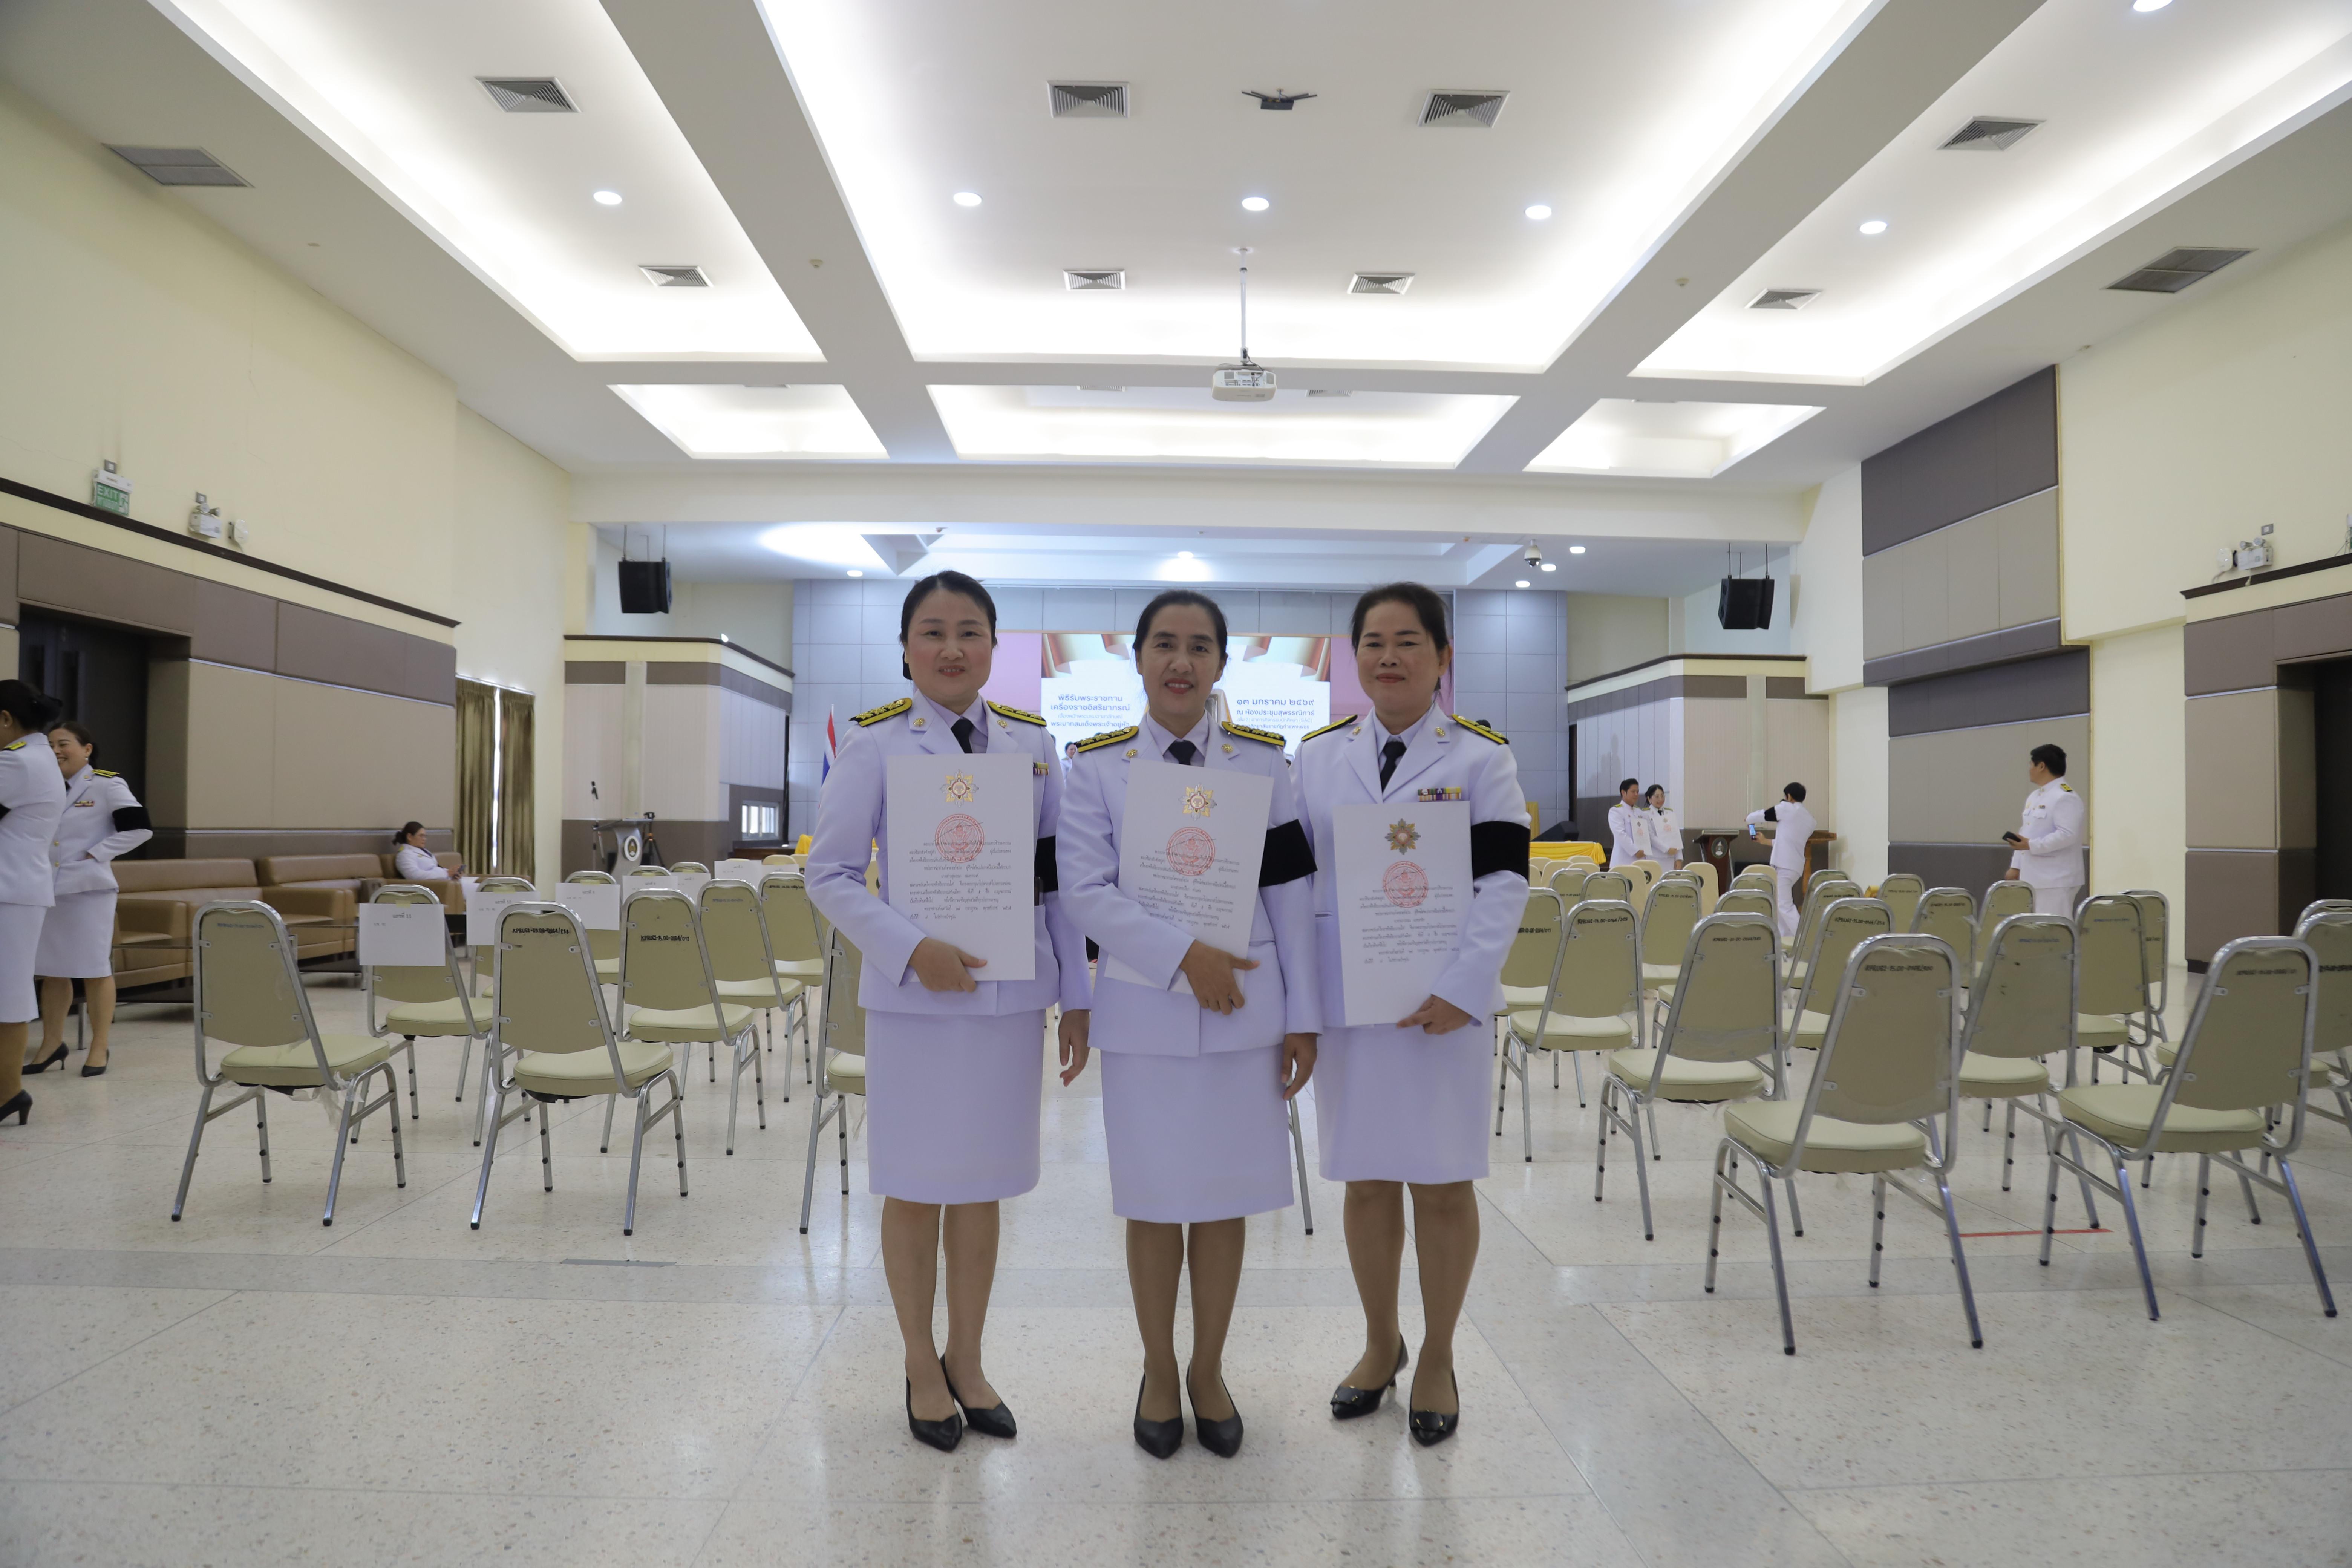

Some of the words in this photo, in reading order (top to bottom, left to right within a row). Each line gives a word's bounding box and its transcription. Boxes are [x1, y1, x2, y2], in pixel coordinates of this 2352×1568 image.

[98, 485, 118, 501] EXIT
[1050, 702, 1130, 711] เครื่องราชอิสริยาภรณ์
